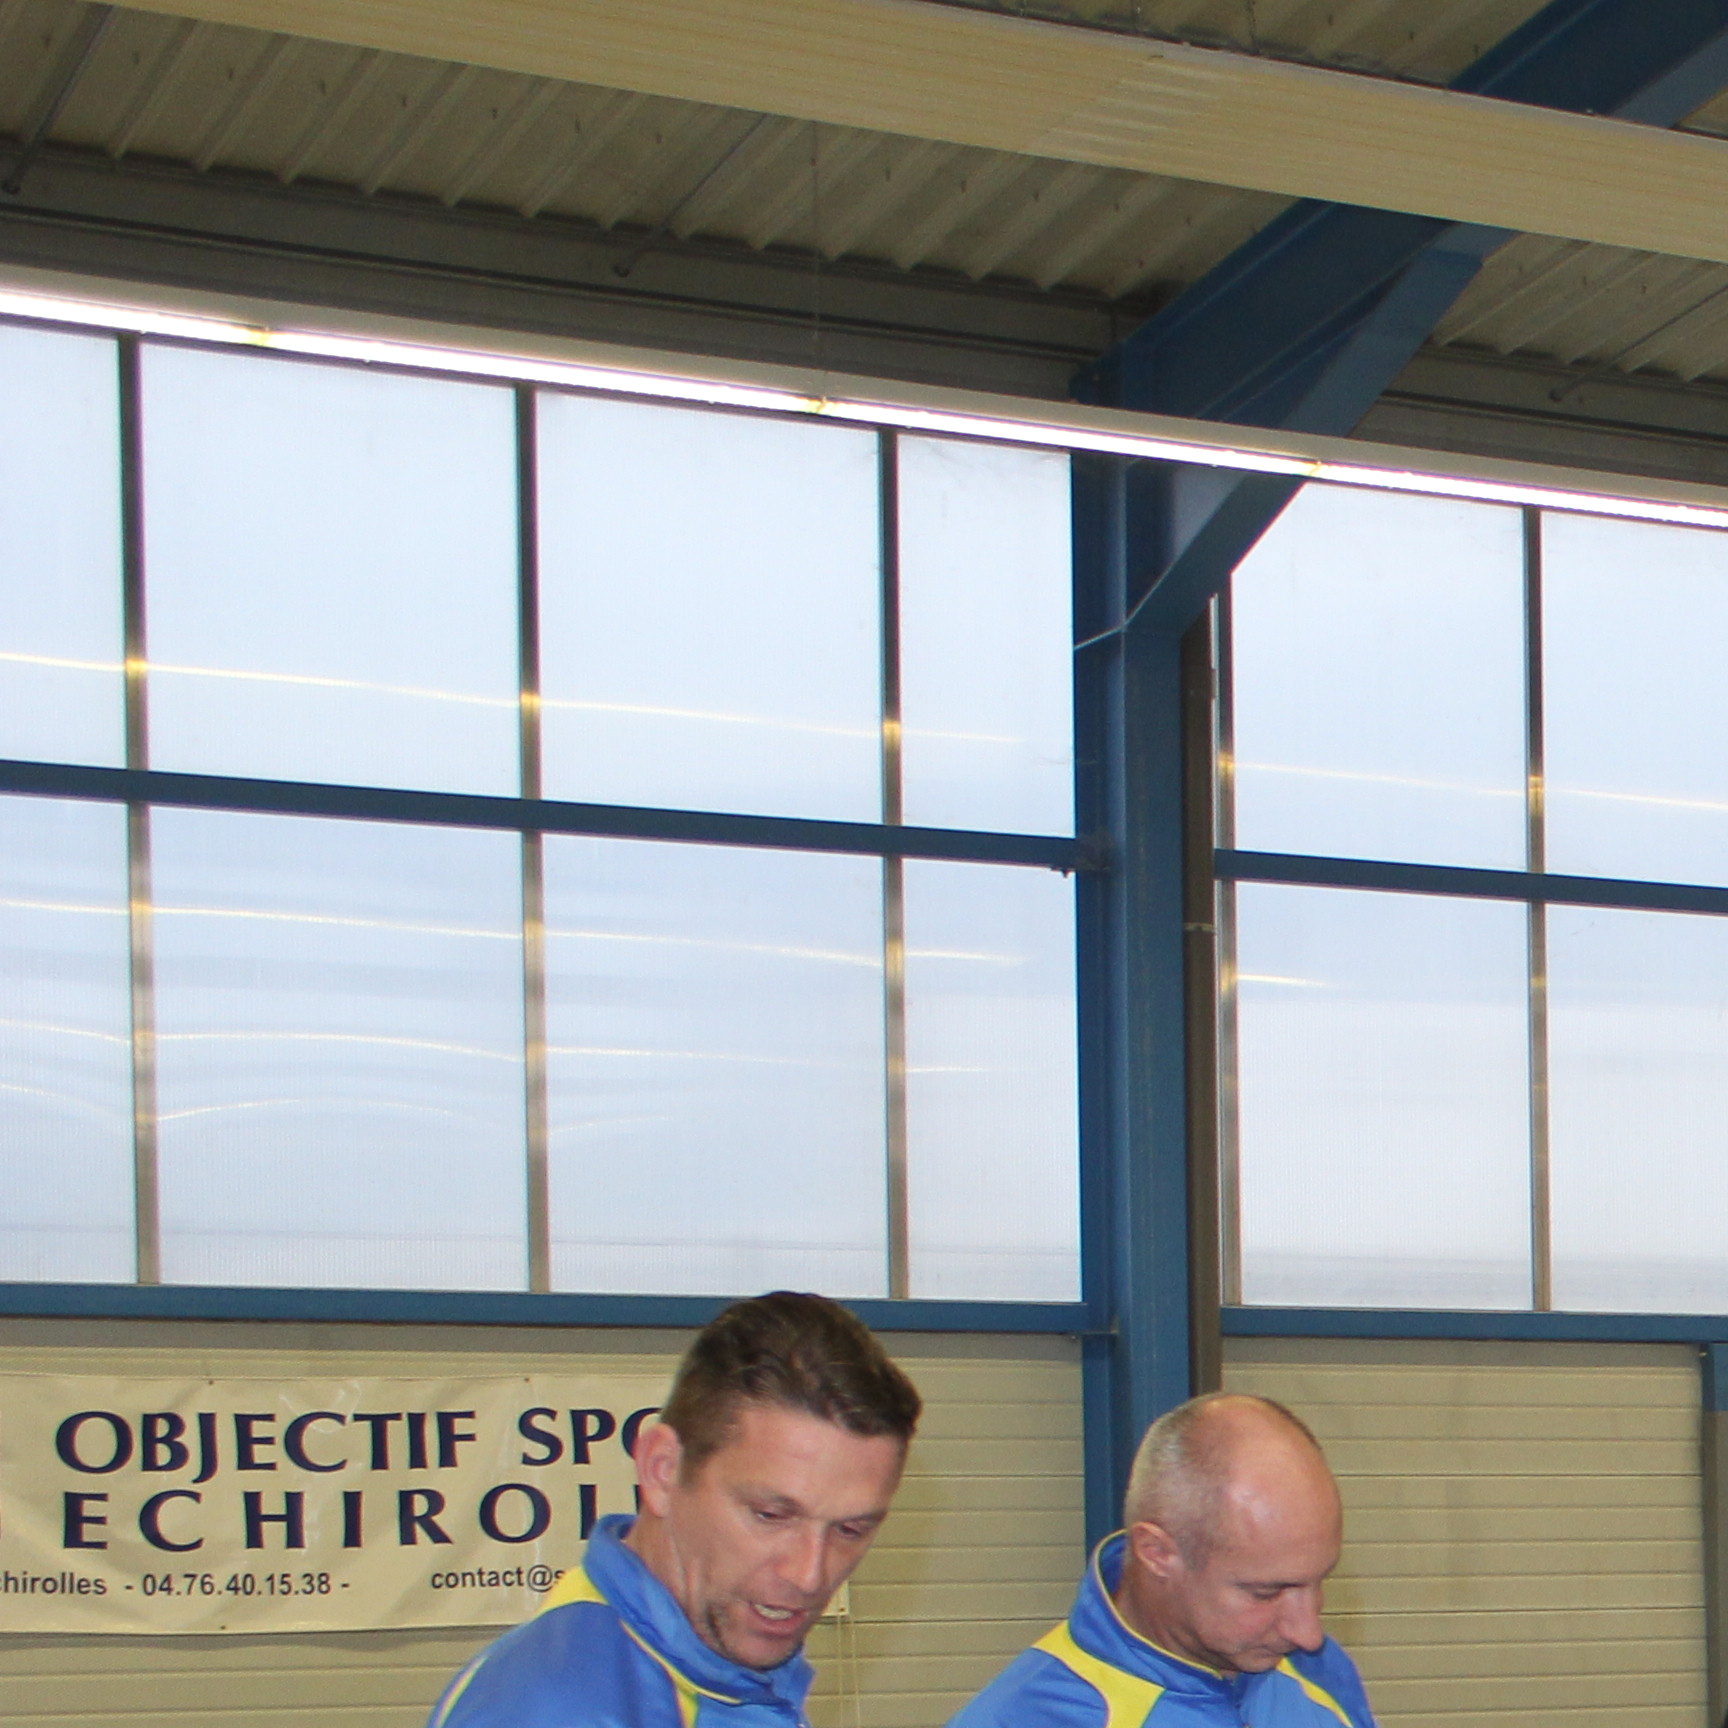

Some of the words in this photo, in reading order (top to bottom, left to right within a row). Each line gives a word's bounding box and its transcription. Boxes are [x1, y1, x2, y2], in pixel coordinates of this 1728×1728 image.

[55, 1408, 477, 1484] OBJECTIF
[0, 1571, 108, 1596] hirolles
[142, 1572, 331, 1597] 04.76.40.15.38
